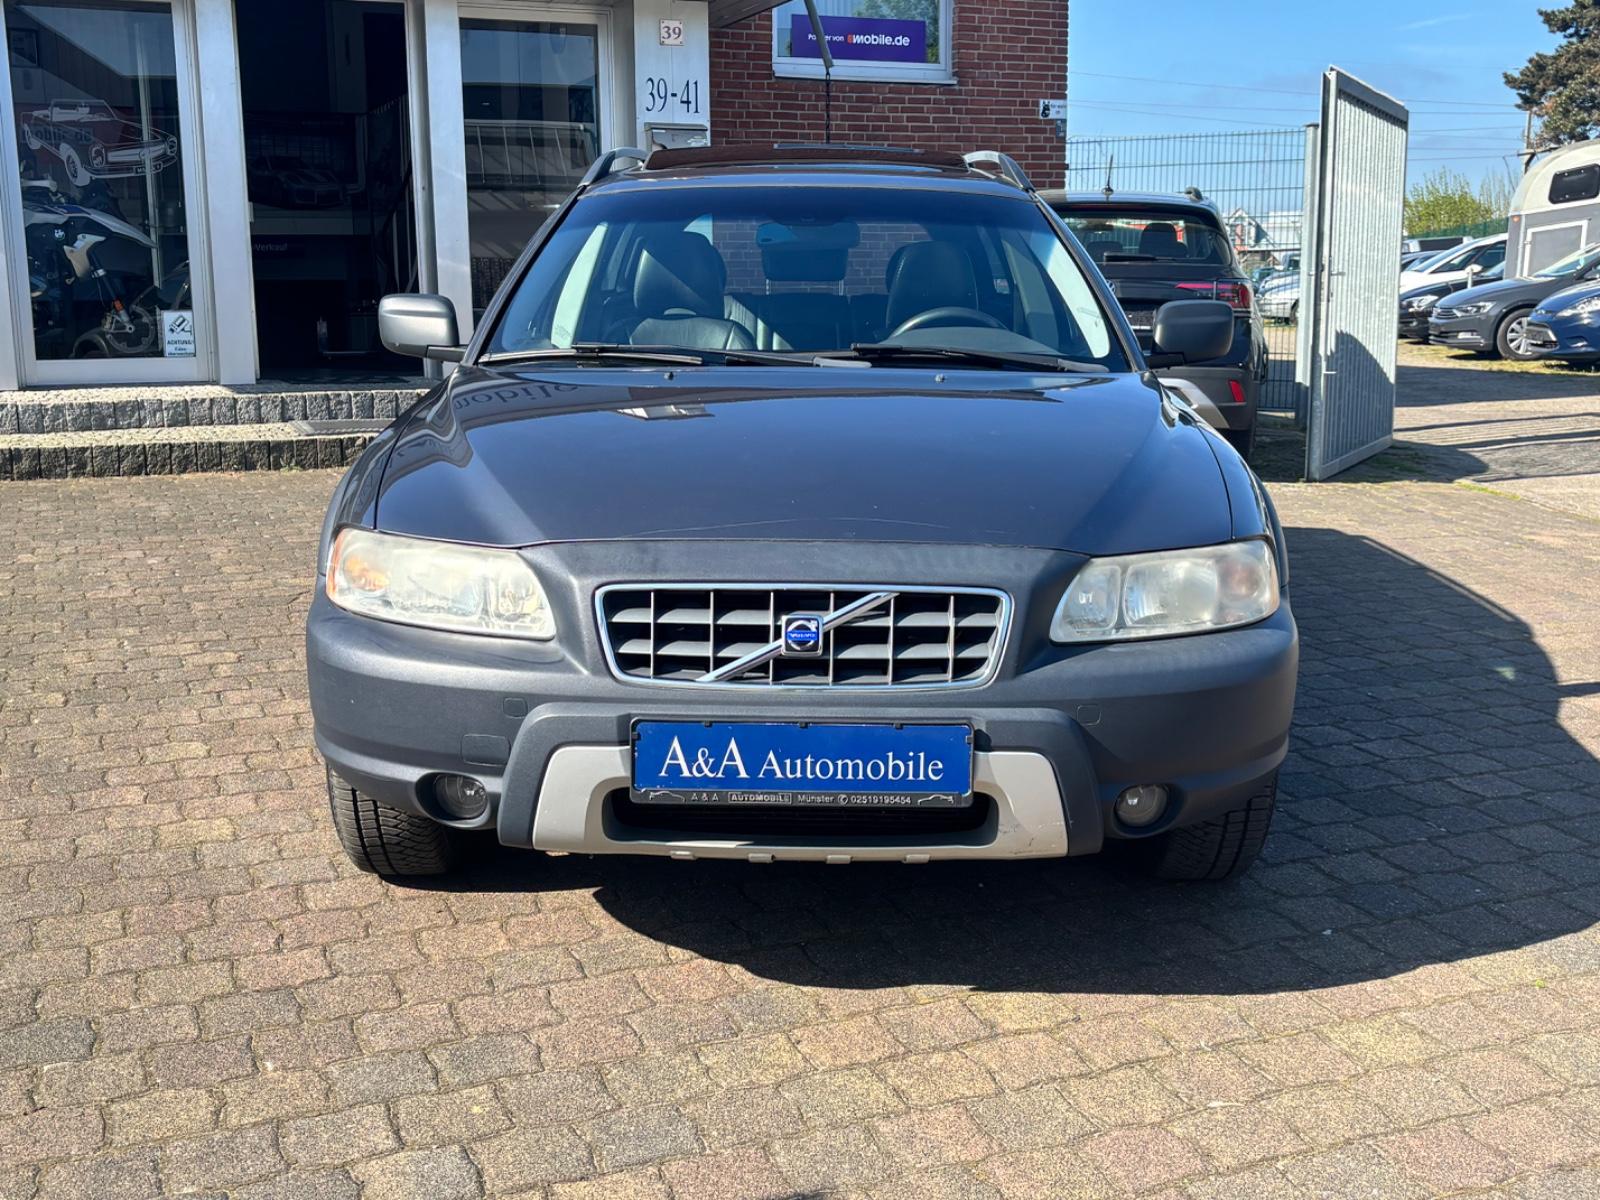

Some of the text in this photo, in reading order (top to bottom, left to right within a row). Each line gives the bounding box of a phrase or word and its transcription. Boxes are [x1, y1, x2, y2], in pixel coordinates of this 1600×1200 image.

[662, 26, 682, 40] 39
[808, 33, 911, 47] Poer von mobile.de
[645, 77, 700, 114] 39-41
[658, 735, 945, 781] A&A Automobile
[797, 794, 834, 805] Münster
